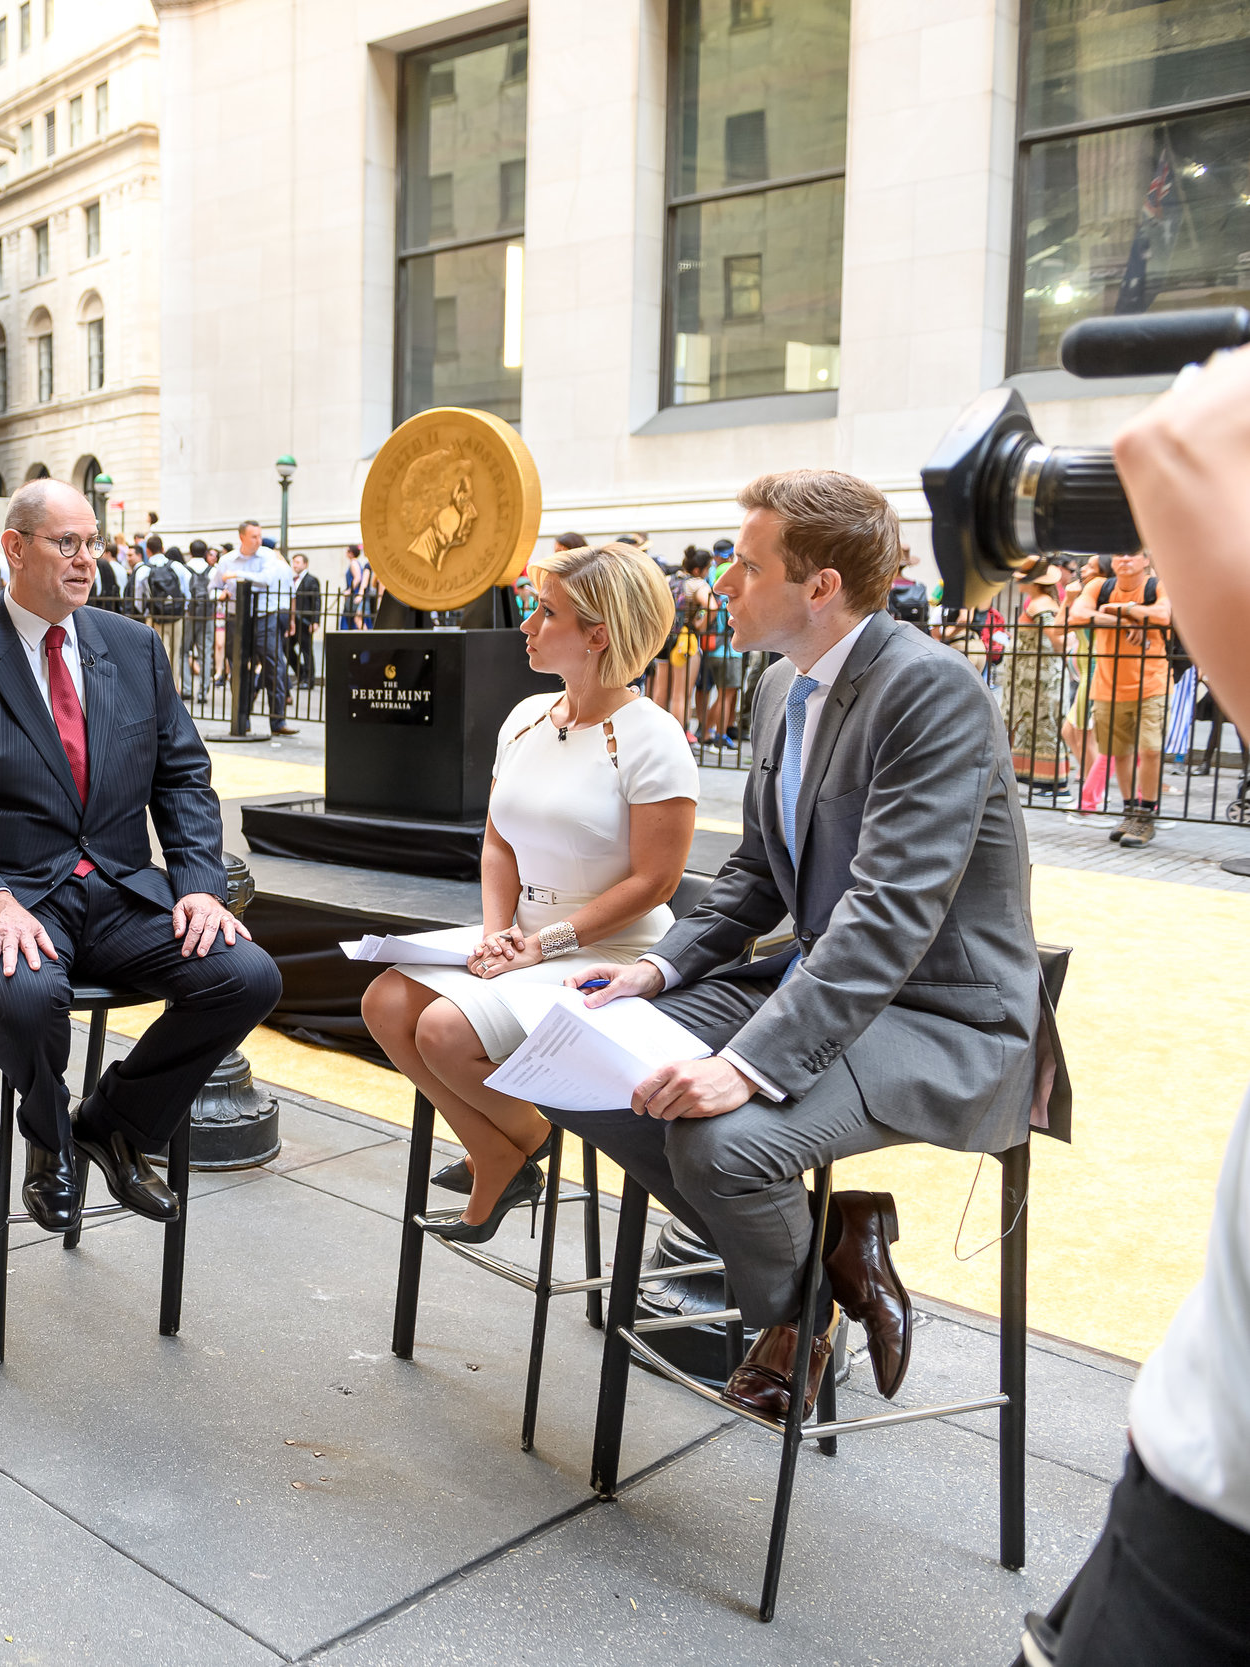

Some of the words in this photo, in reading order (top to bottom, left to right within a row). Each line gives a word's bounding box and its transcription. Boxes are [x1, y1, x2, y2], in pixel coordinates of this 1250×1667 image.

[374, 436, 423, 540] ELIZABETH
[427, 431, 439, 446] II
[463, 436, 510, 534] AUSTRALIA
[431, 547, 496, 593] DOLLARS
[352, 688, 393, 700] PERTH
[397, 690, 431, 701] MINT
